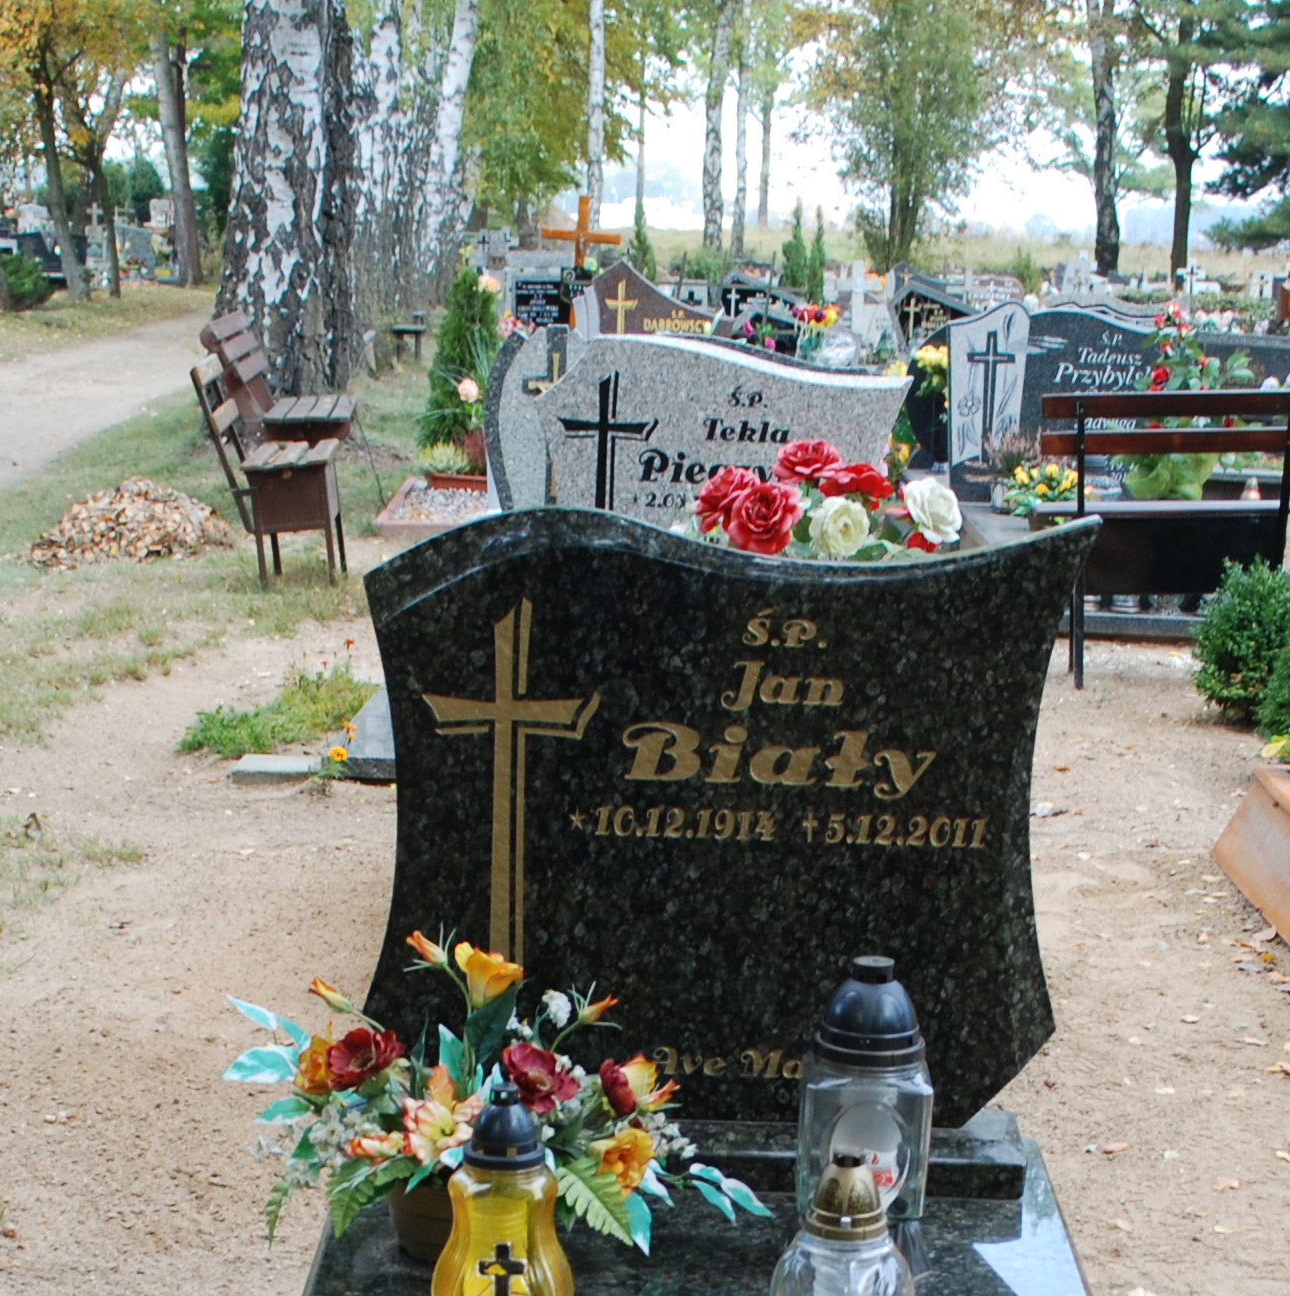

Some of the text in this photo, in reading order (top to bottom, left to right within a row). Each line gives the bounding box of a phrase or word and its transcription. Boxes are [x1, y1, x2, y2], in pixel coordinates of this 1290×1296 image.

[1077, 346, 1143, 366] Tadeusz
[727, 385, 769, 408] Ś.P.
[702, 417, 791, 443] Tekla
[741, 605, 829, 649] Ś.P.
[720, 659, 847, 712] Jan
[621, 720, 938, 801] Biały
[594, 804, 990, 850] 10.12.1914 5.12.2011
[652, 1045, 729, 1077] Ave
